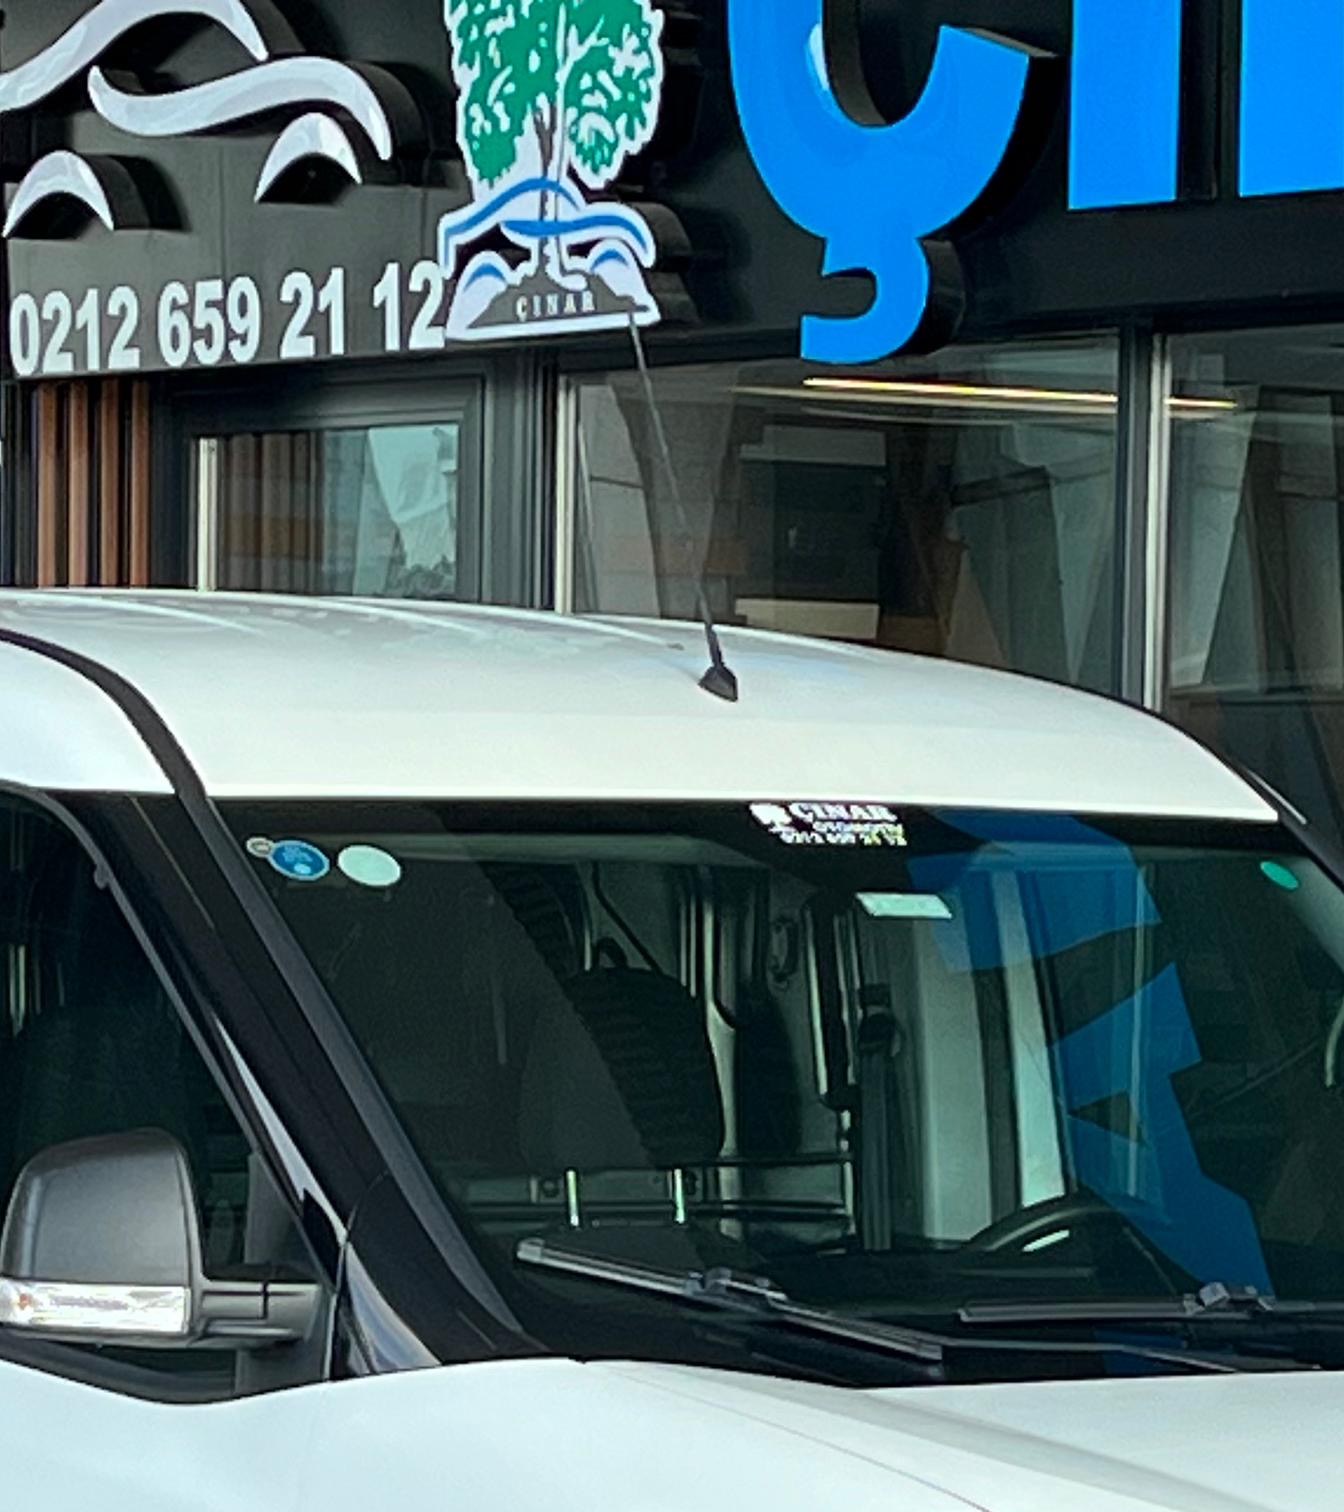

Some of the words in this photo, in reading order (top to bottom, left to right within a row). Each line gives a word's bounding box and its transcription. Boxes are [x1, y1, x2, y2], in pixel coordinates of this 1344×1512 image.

[9, 286, 141, 376] 0212
[158, 276, 261, 368] 659
[279, 266, 345, 359] 21
[372, 260, 446, 352] 12
